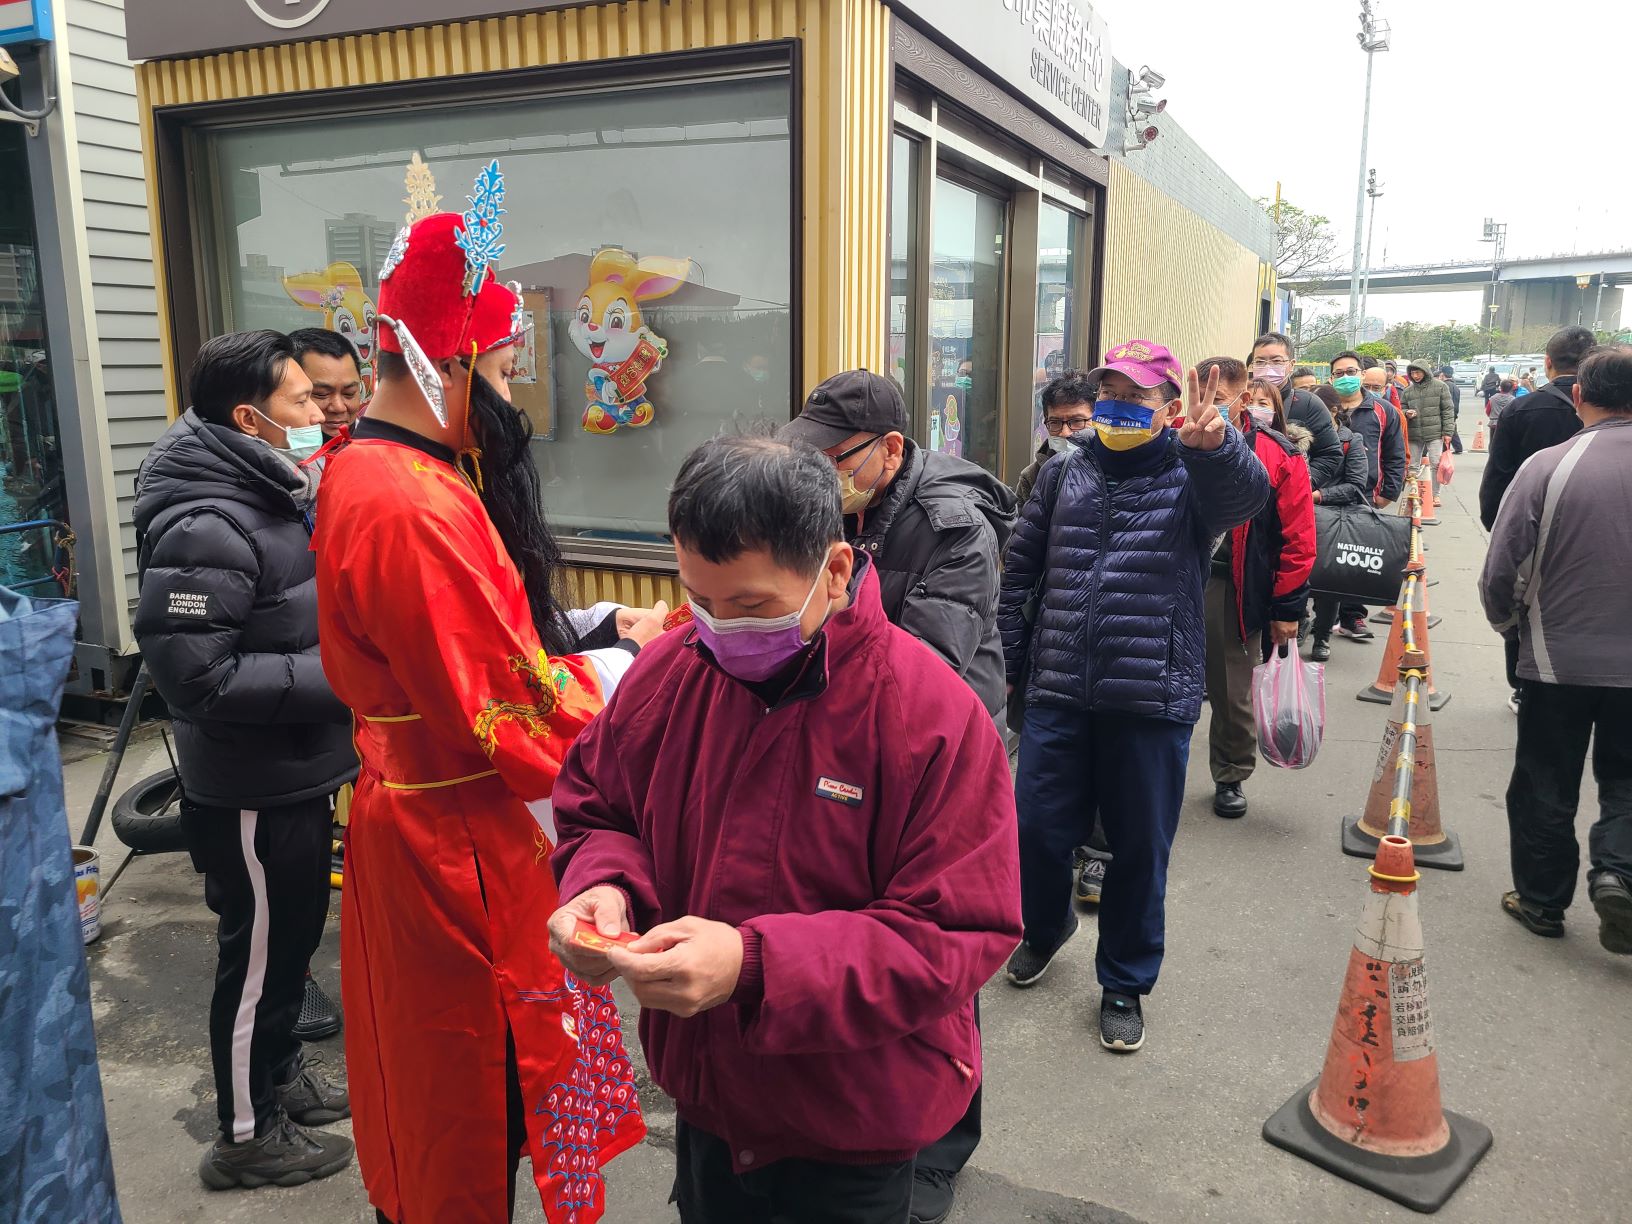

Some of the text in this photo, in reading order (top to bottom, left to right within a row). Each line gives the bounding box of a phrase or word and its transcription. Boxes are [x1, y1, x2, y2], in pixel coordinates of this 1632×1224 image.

[1030, 47, 1101, 131] SERVICE CENTER
[1095, 415, 1142, 428] STAND WITH
[1337, 542, 1385, 556] NATURALLY
[1335, 550, 1384, 570] JOJO
[169, 592, 209, 602] BARERRY
[168, 606, 207, 616] ENGLAND
[171, 600, 206, 609] LONDON
